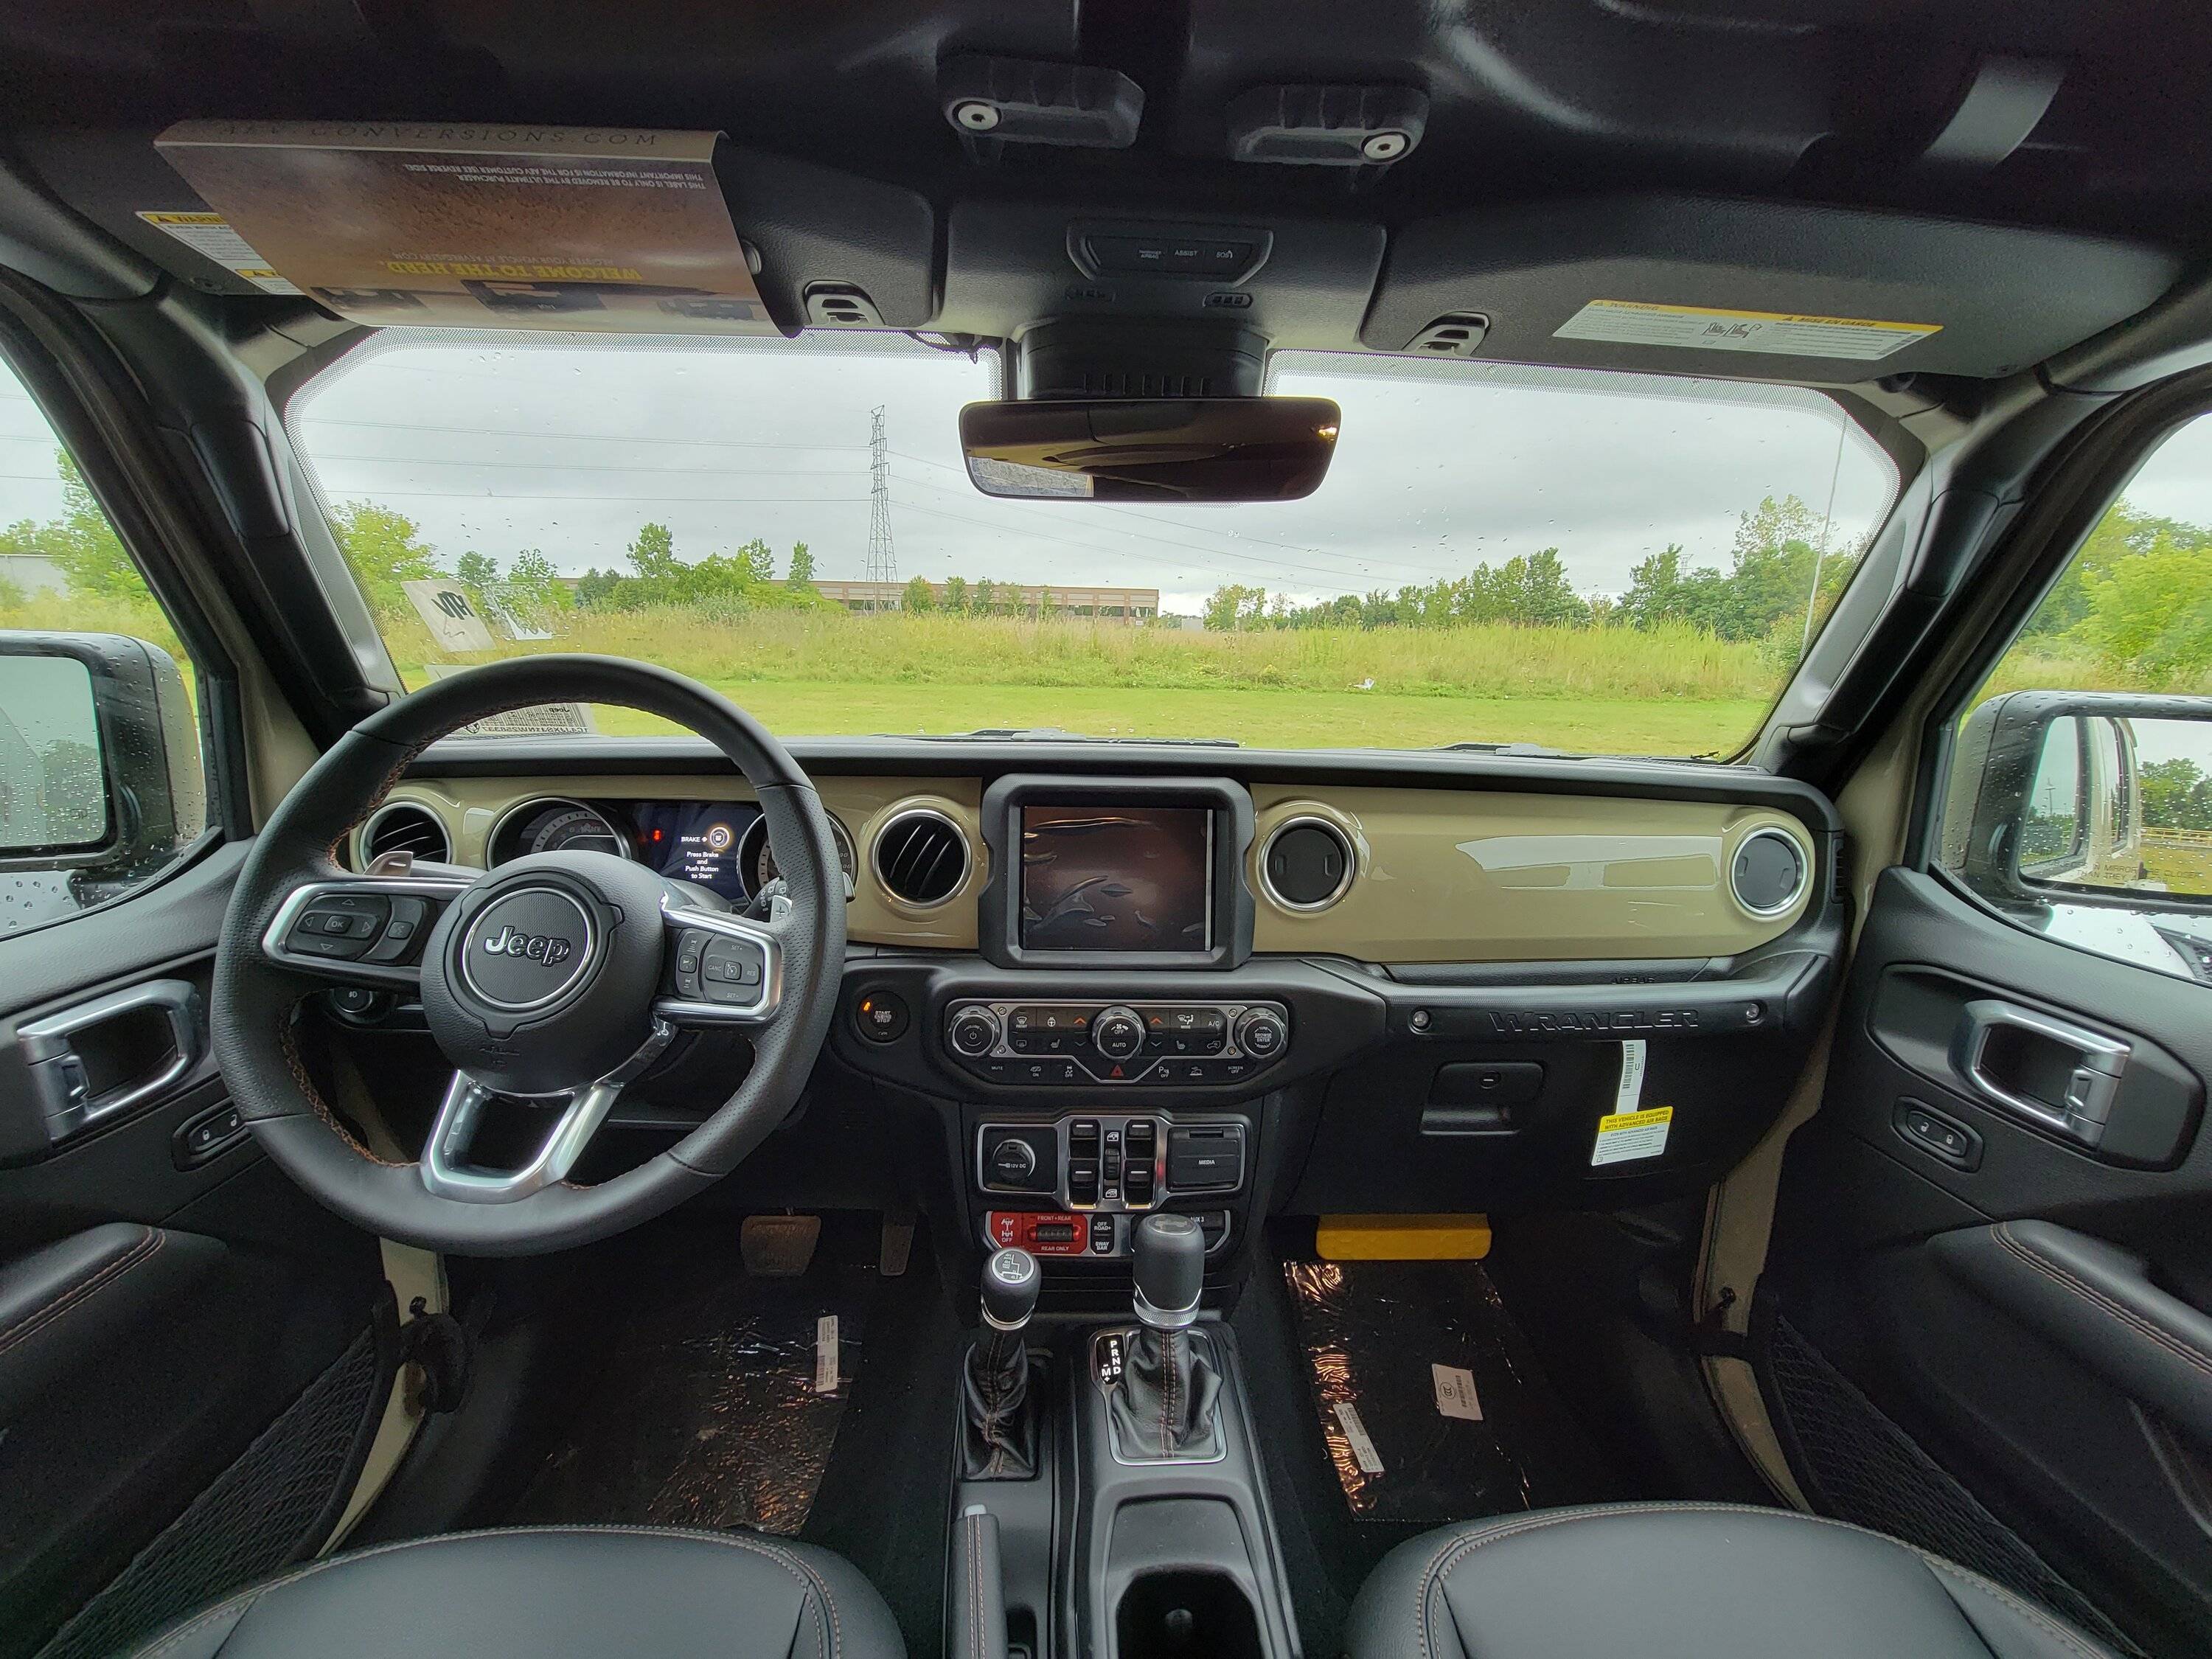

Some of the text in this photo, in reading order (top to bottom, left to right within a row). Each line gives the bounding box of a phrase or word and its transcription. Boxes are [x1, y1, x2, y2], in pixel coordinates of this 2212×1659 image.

[479, 166, 524, 174] CUSTOMER
[524, 167, 540, 175] AEV
[640, 172, 684, 180] IMPORTANT
[684, 173, 703, 181] THIS
[686, 181, 706, 189] THIS
[449, 262, 500, 276] THE
[500, 264, 532, 277] TO
[533, 265, 643, 279] WELCOME
[1609, 302, 1660, 311] WARNING
[331, 920, 344, 929] OK
[484, 925, 571, 967] Jeep
[1488, 1009, 1700, 1032] WRANGLER
[1646, 1110, 1669, 1118] EQUIPPED
[1618, 1119, 1645, 1128] ADVANCED
[1110, 1340, 1118, 1349] P
[1111, 1349, 1119, 1357] R
[1112, 1357, 1121, 1366] N
[1101, 1368, 1111, 1377] M
[1113, 1366, 1121, 1375] D
